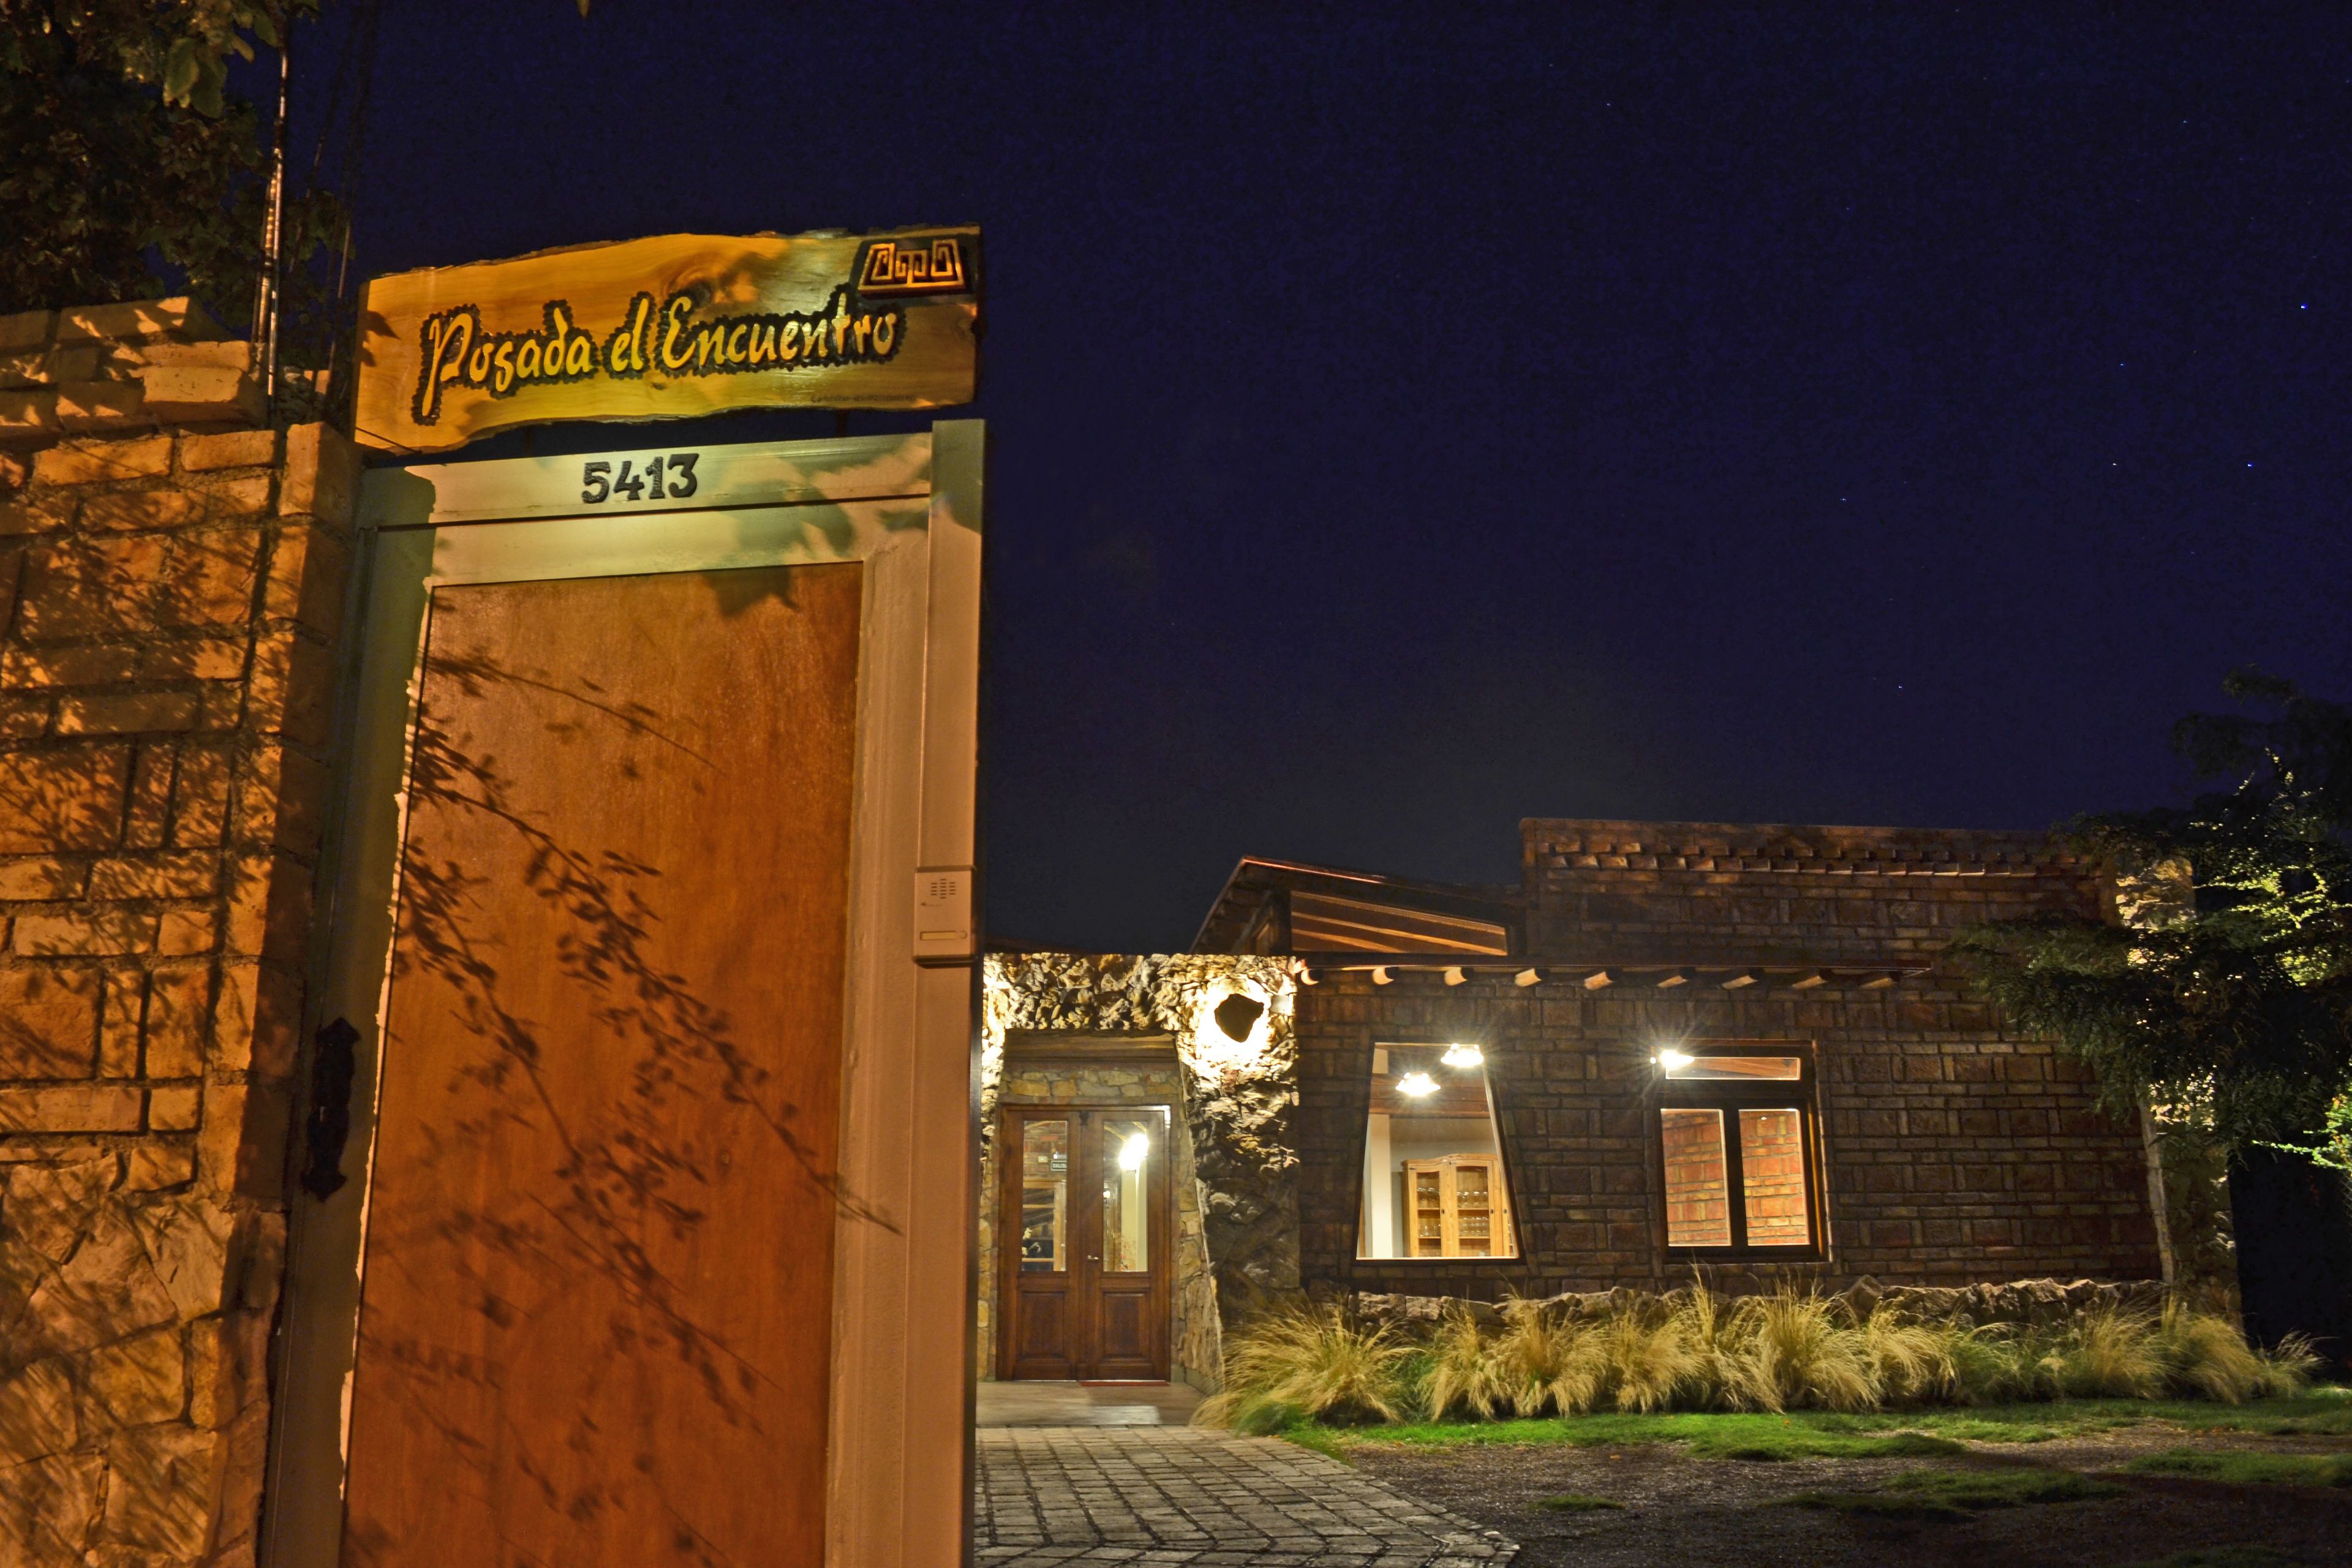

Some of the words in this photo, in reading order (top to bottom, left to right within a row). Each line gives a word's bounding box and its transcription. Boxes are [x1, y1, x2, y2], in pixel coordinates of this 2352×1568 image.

[422, 307, 592, 417] Posada
[610, 298, 649, 372] el
[662, 295, 897, 369] Encuentro
[581, 453, 699, 503] 5413
